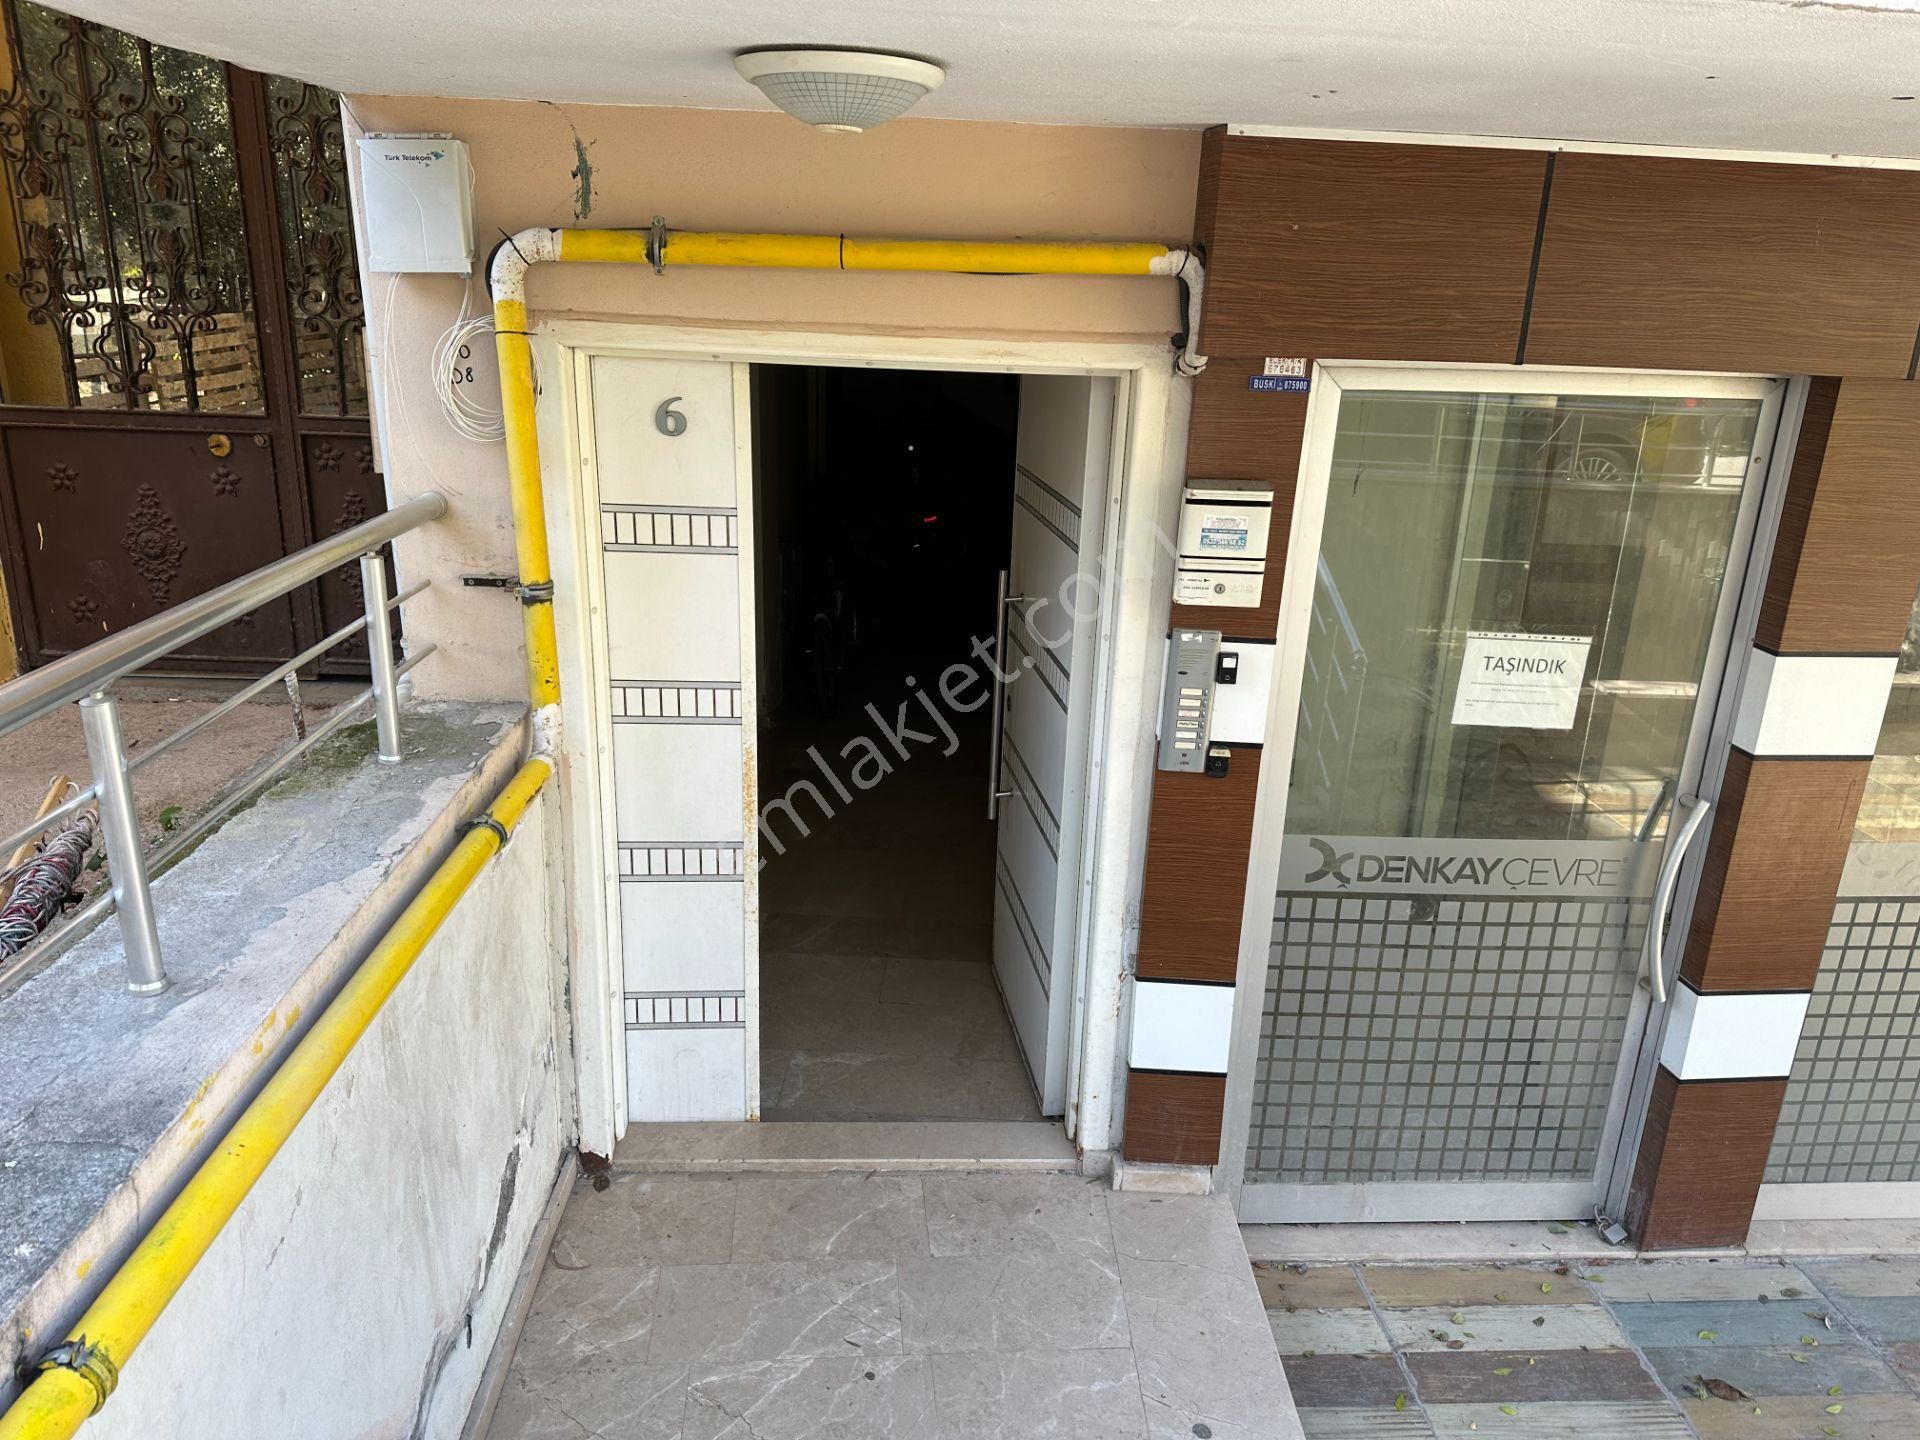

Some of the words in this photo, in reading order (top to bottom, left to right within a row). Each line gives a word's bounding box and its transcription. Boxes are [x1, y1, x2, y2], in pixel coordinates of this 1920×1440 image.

[402, 154, 432, 162] Telekom
[655, 396, 687, 437] 6
[1483, 655, 1567, 676] TAŞINDIK
